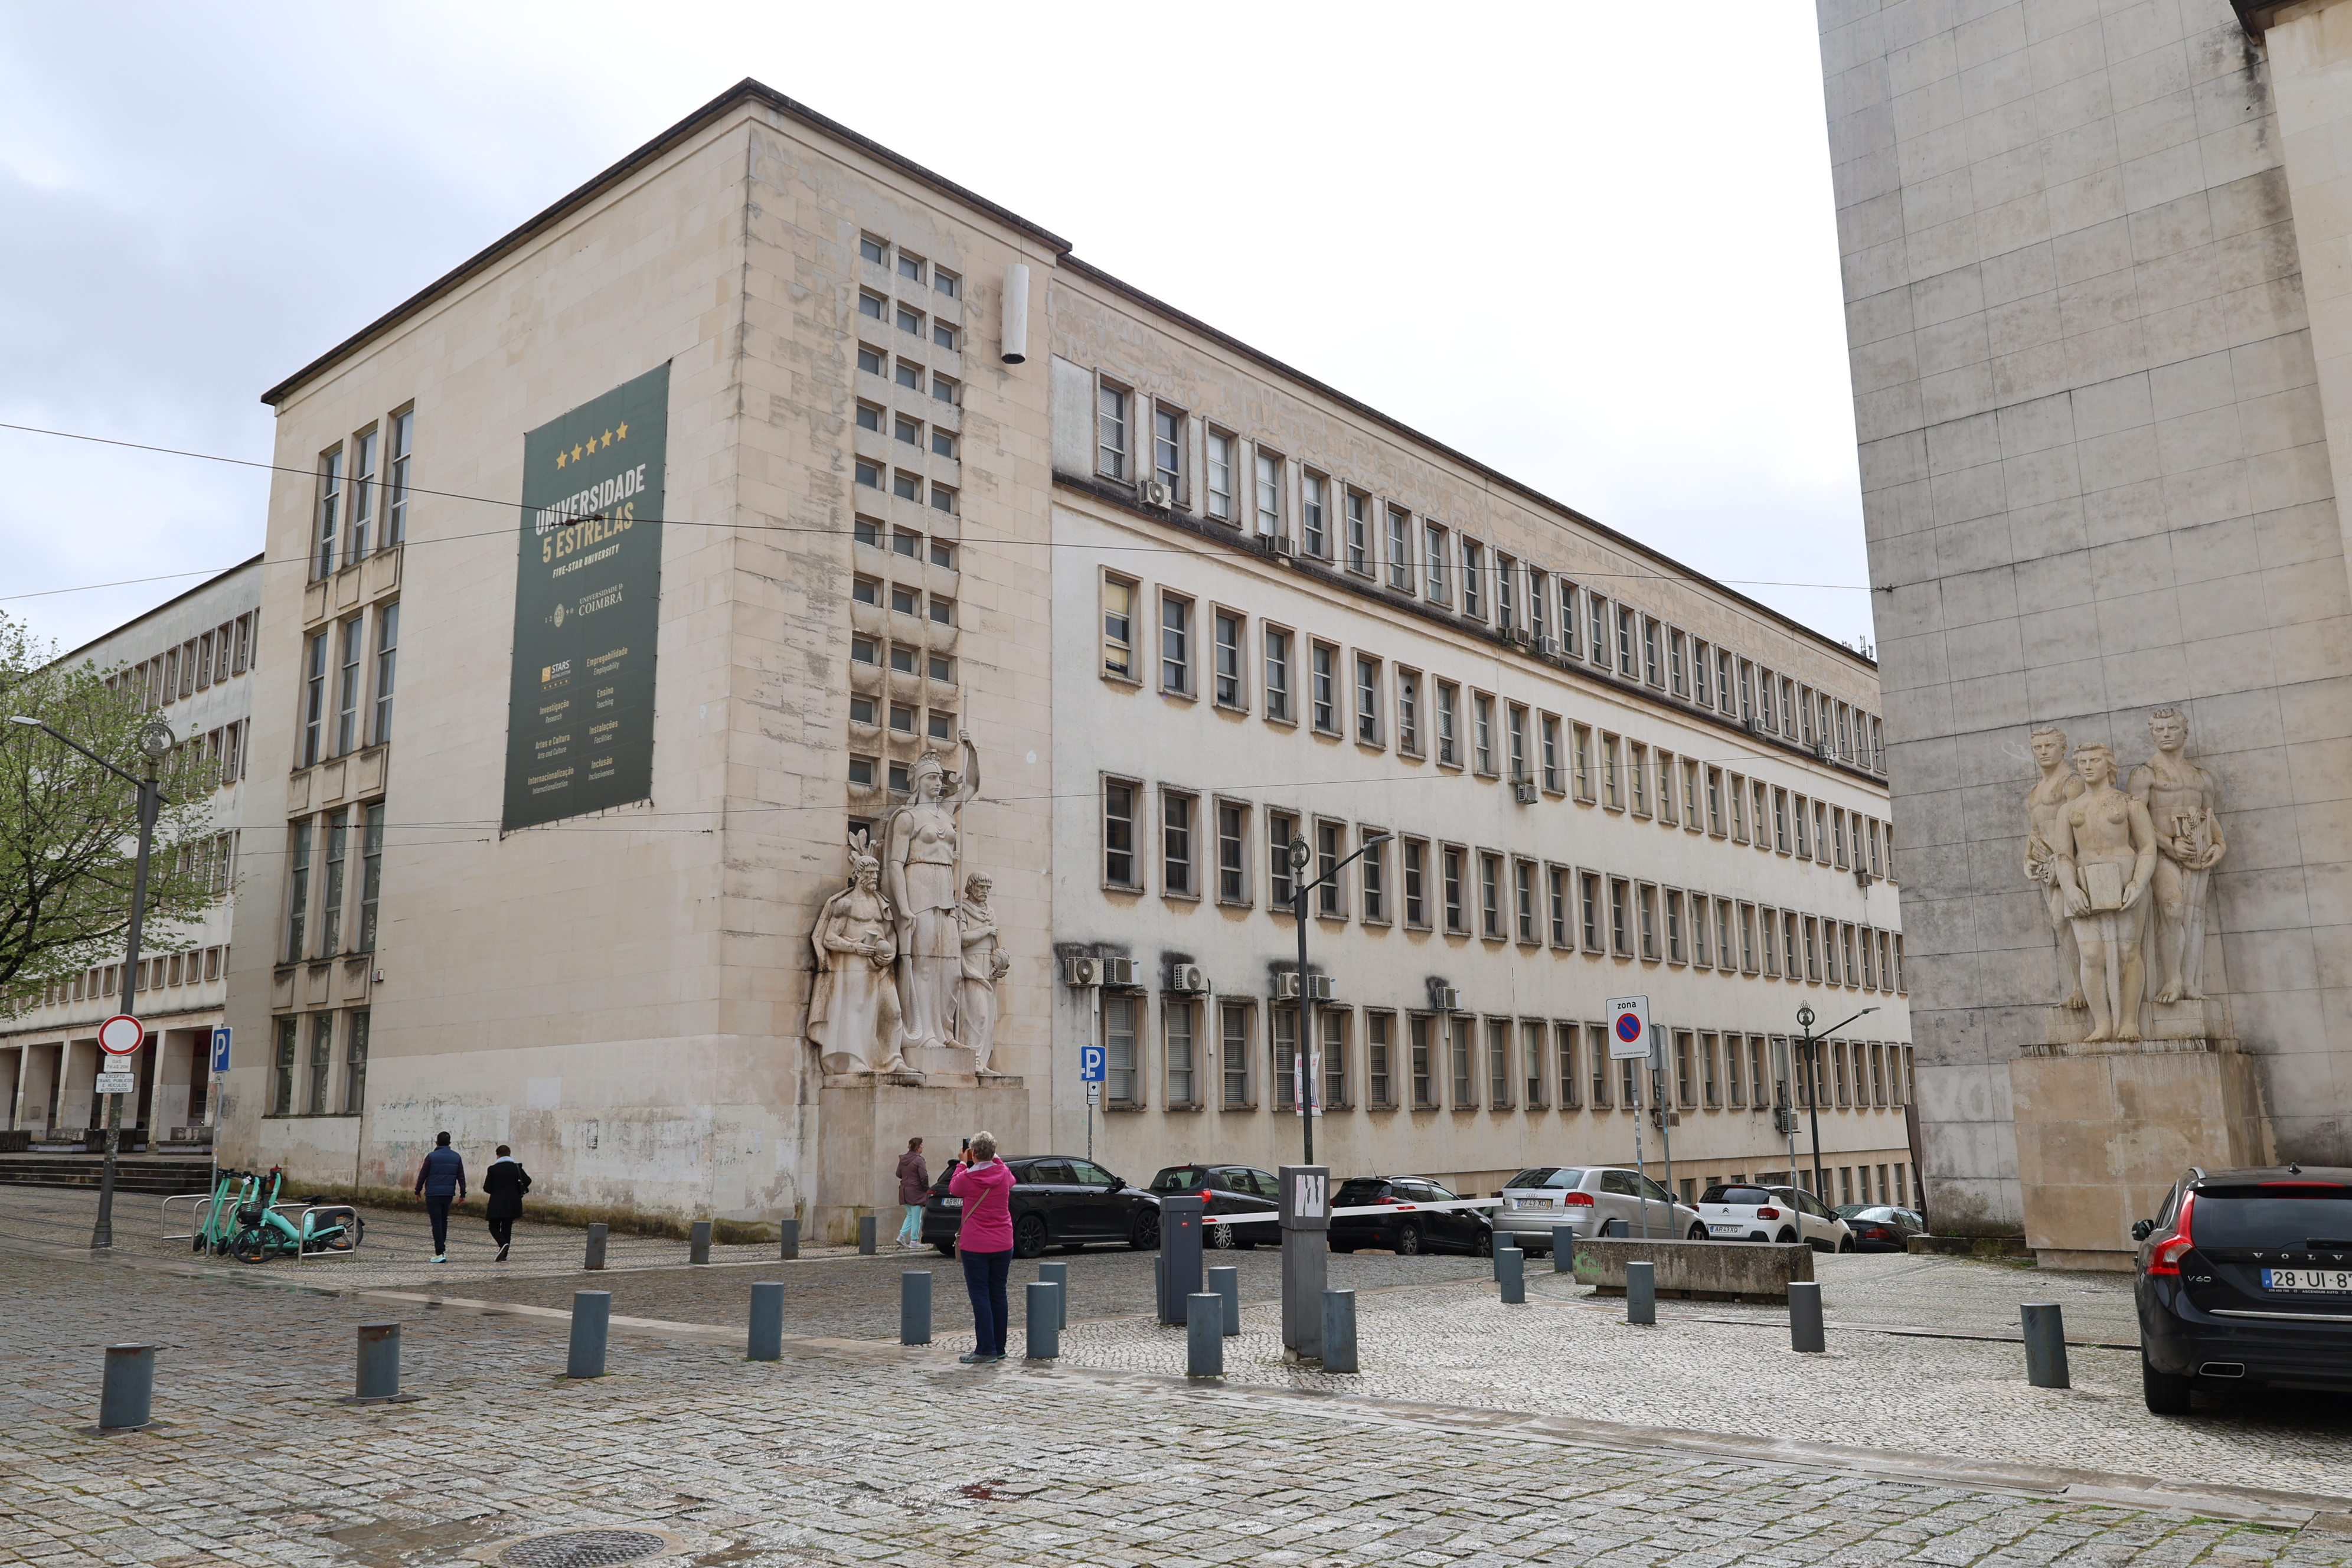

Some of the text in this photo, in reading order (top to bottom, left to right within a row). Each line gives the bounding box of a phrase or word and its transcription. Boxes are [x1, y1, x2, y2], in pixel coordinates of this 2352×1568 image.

[535, 463, 646, 536] UNIVERSIDADE
[543, 501, 634, 563] 5 ESTRELAS
[552, 543, 619, 579] FIVE-STAR UNIVERSITY
[579, 584, 618, 605] UNIVERSIDADE
[579, 591, 623, 616] COIMBRA
[586, 646, 628, 667] Empregabilidade
[551, 660, 570, 674] STARS
[593, 662, 619, 675] Employability
[597, 687, 614, 698] Ensino
[539, 700, 570, 715] Investigação
[596, 698, 614, 709] Teaching
[545, 713, 562, 724] Research
[589, 720, 618, 735] Instalações
[535, 740, 547, 750] Artes
[553, 734, 570, 745] Cultura
[594, 733, 612, 744] Facilities
[553, 746, 567, 756] Culture
[591, 756, 613, 769] Inclusão
[528, 767, 574, 785] Internacionalização
[588, 769, 615, 780] Inclusiveness
[215, 1033, 226, 1067] P
[1086, 1049, 1100, 1078] P
